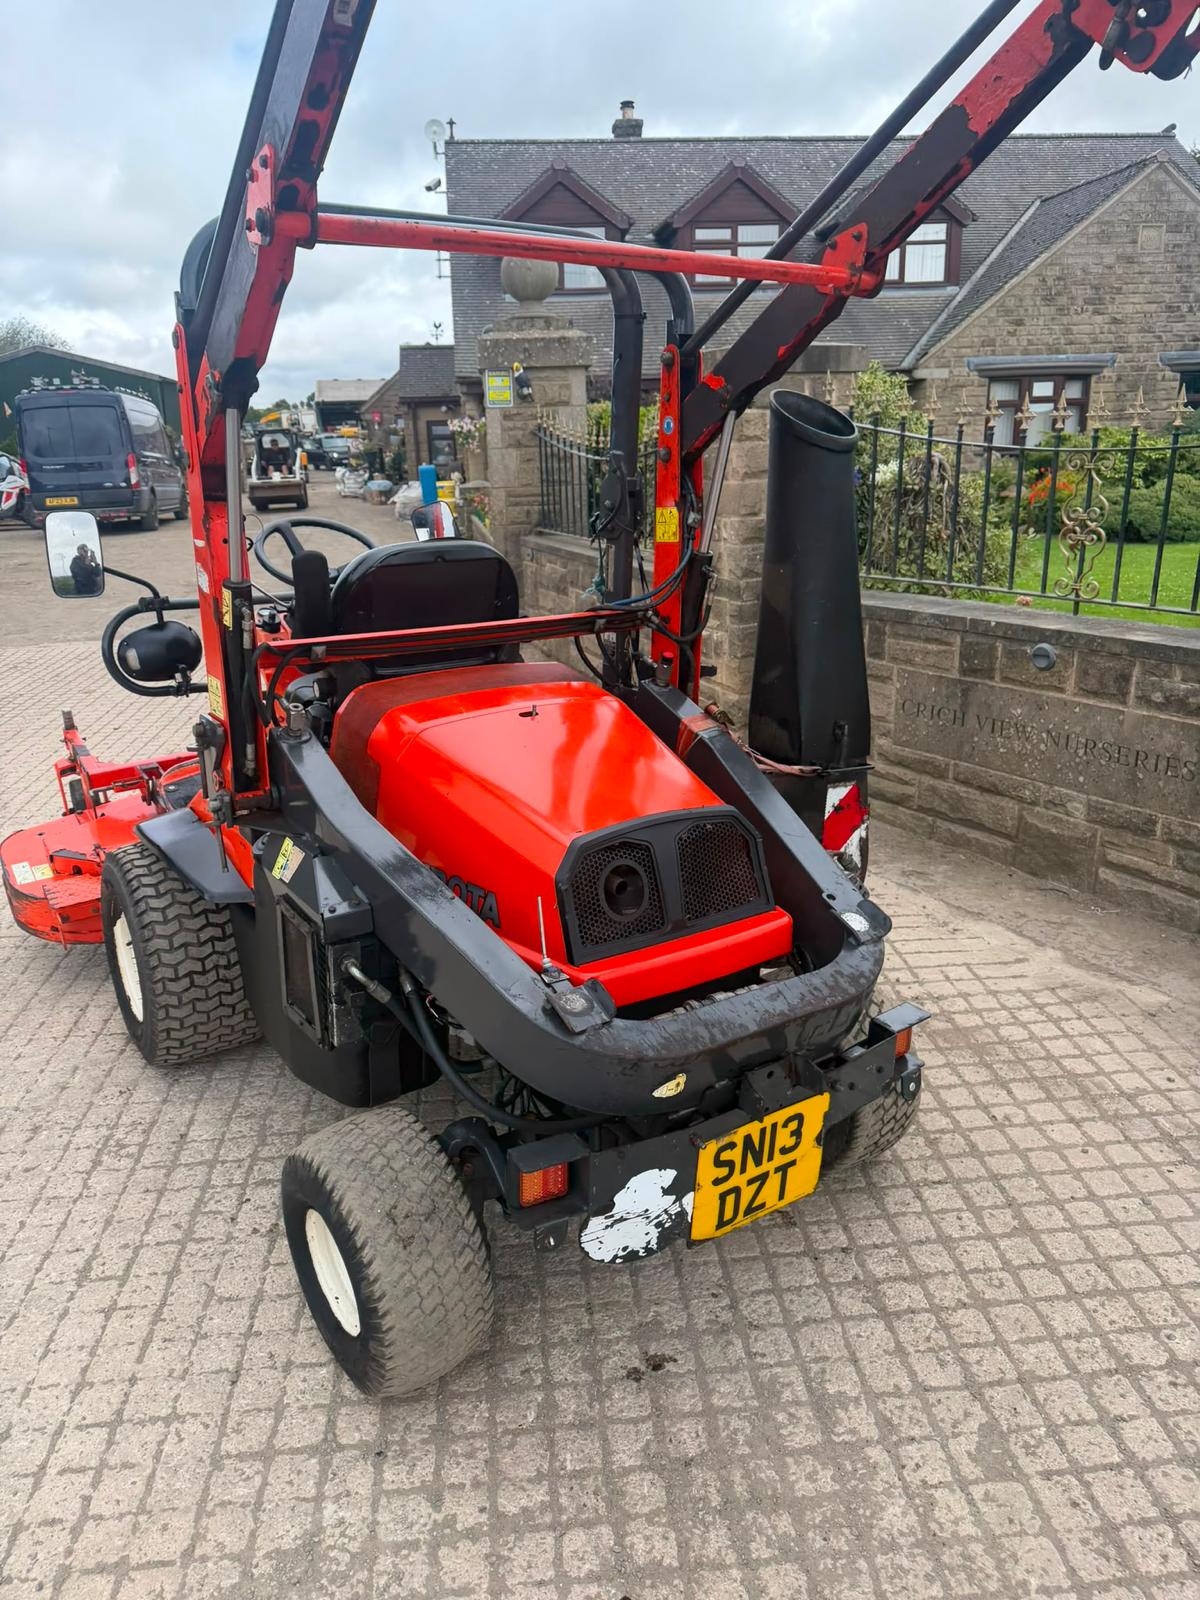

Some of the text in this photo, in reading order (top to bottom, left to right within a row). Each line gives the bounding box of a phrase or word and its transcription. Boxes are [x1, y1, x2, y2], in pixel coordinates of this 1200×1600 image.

[901, 699, 1197, 782] CRICH VIEW NURSERIES
[711, 1112, 805, 1187] SN13
[715, 1158, 797, 1231] DZT
